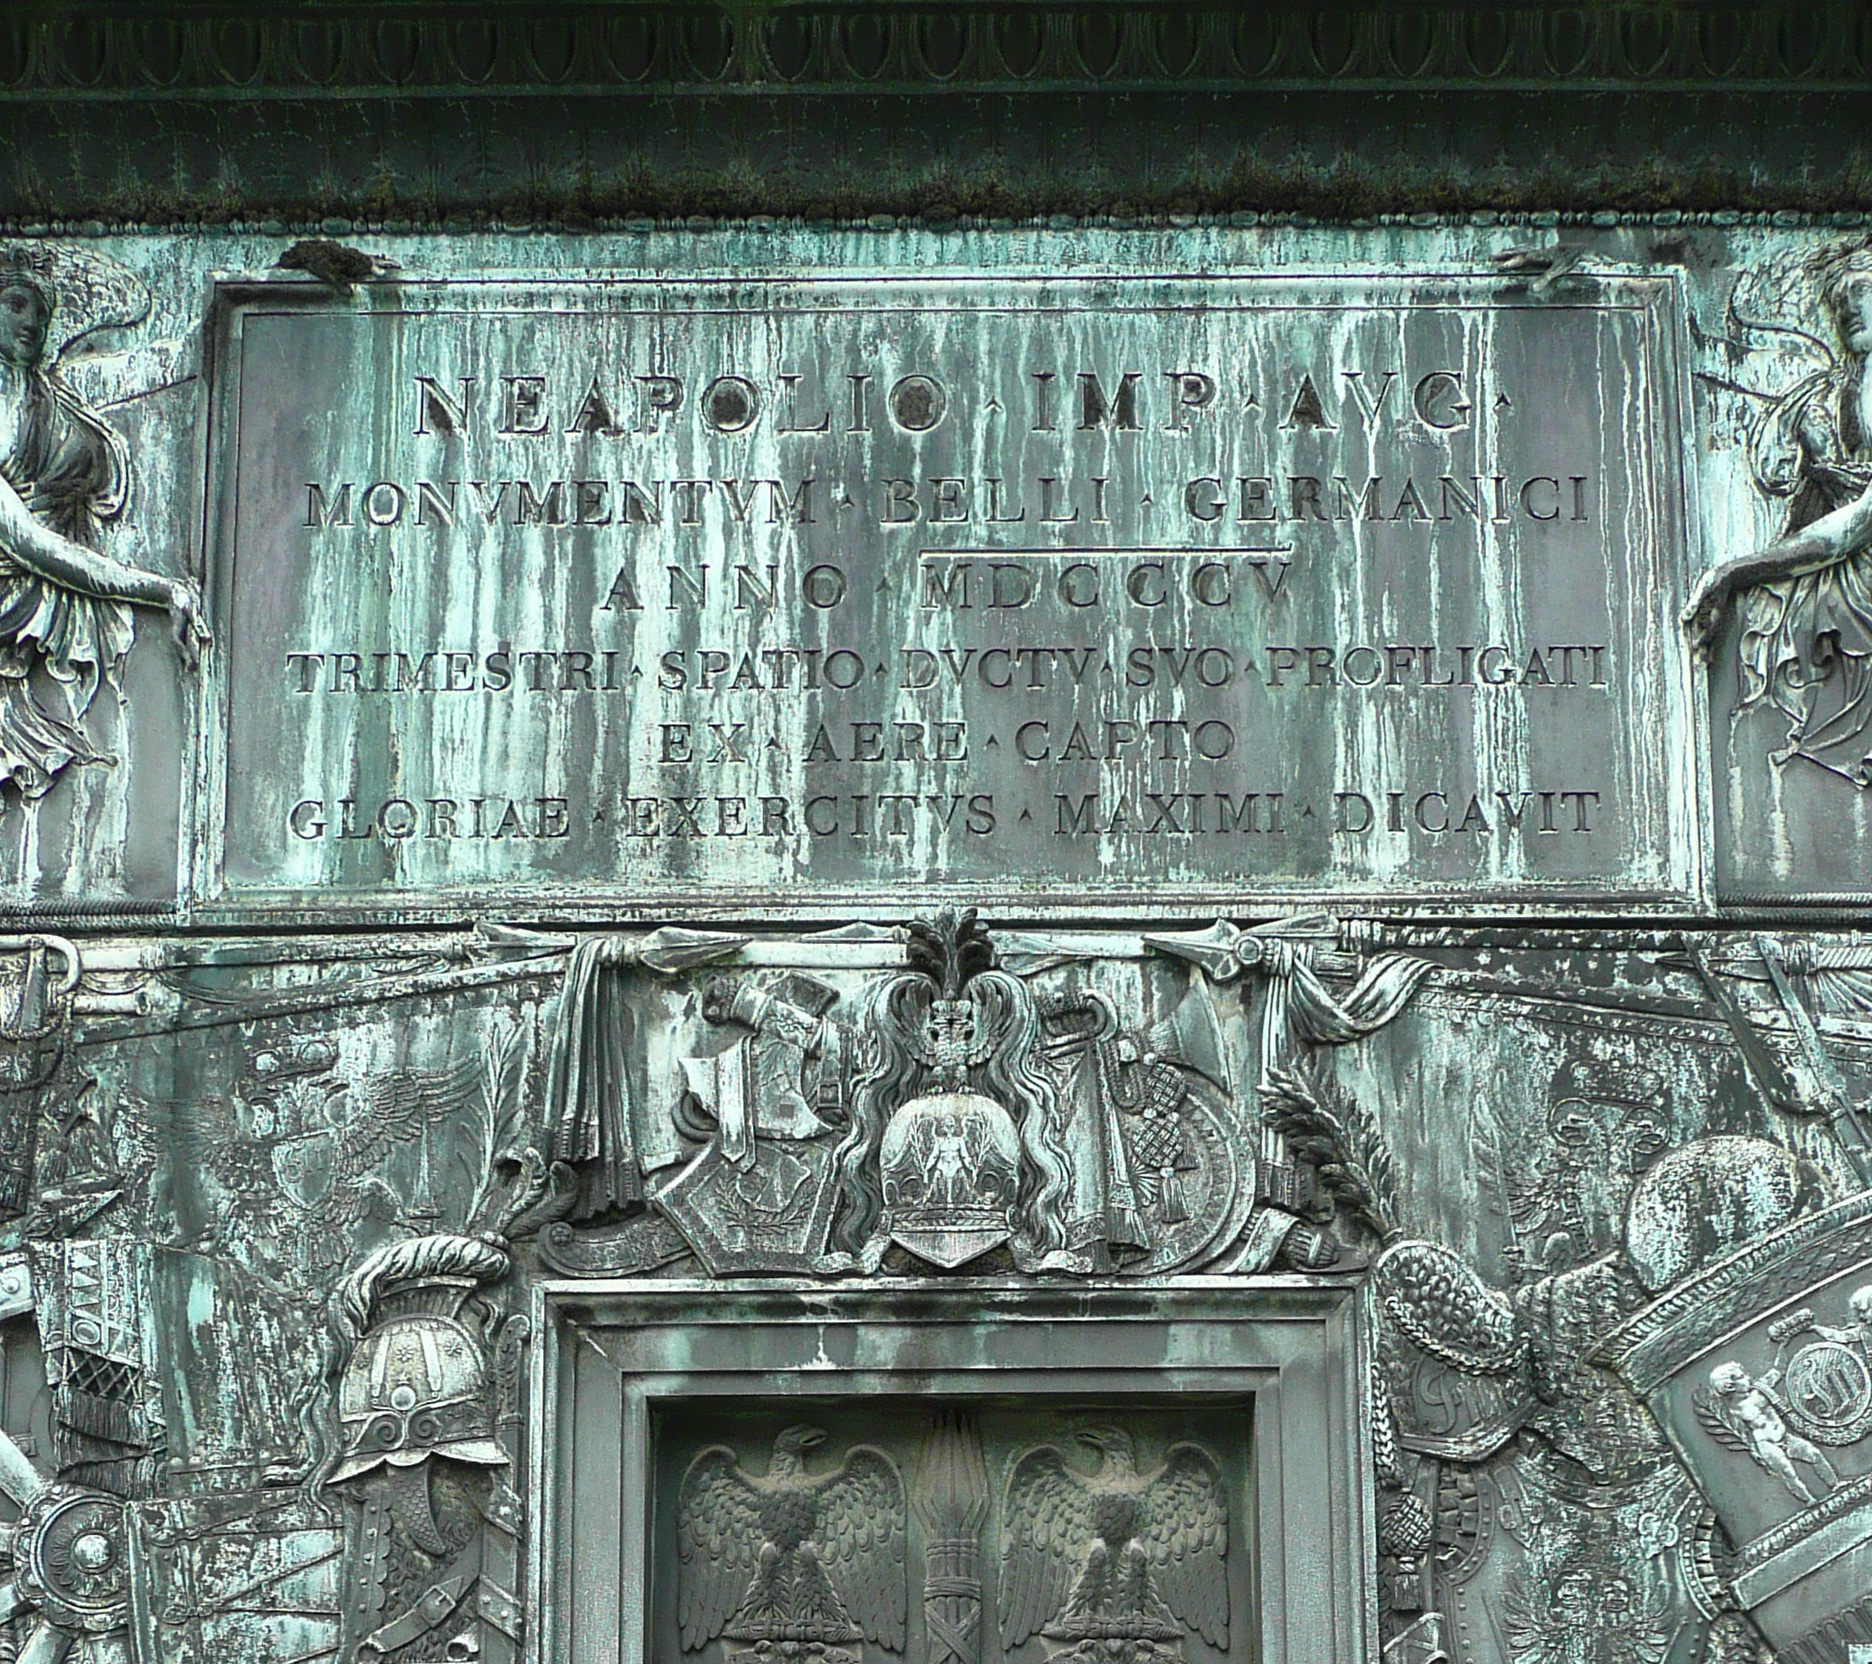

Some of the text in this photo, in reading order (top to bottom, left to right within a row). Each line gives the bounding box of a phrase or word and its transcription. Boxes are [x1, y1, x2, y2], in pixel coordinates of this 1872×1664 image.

[414, 371, 1472, 438] NEAPOLIO IMP AVG
[302, 475, 1588, 531] MONVMENTVM BELLI GERMANICI
[599, 561, 1292, 611] ANNO MDCCCV
[286, 645, 1607, 693] TRIMESTRI SPATIO DVCTV SVO PROFLIGATI
[657, 720, 1235, 766] EX AERE CAPTO
[288, 791, 1600, 841] GLORIAE EXERCITVS MAXIMI DICAVIT
